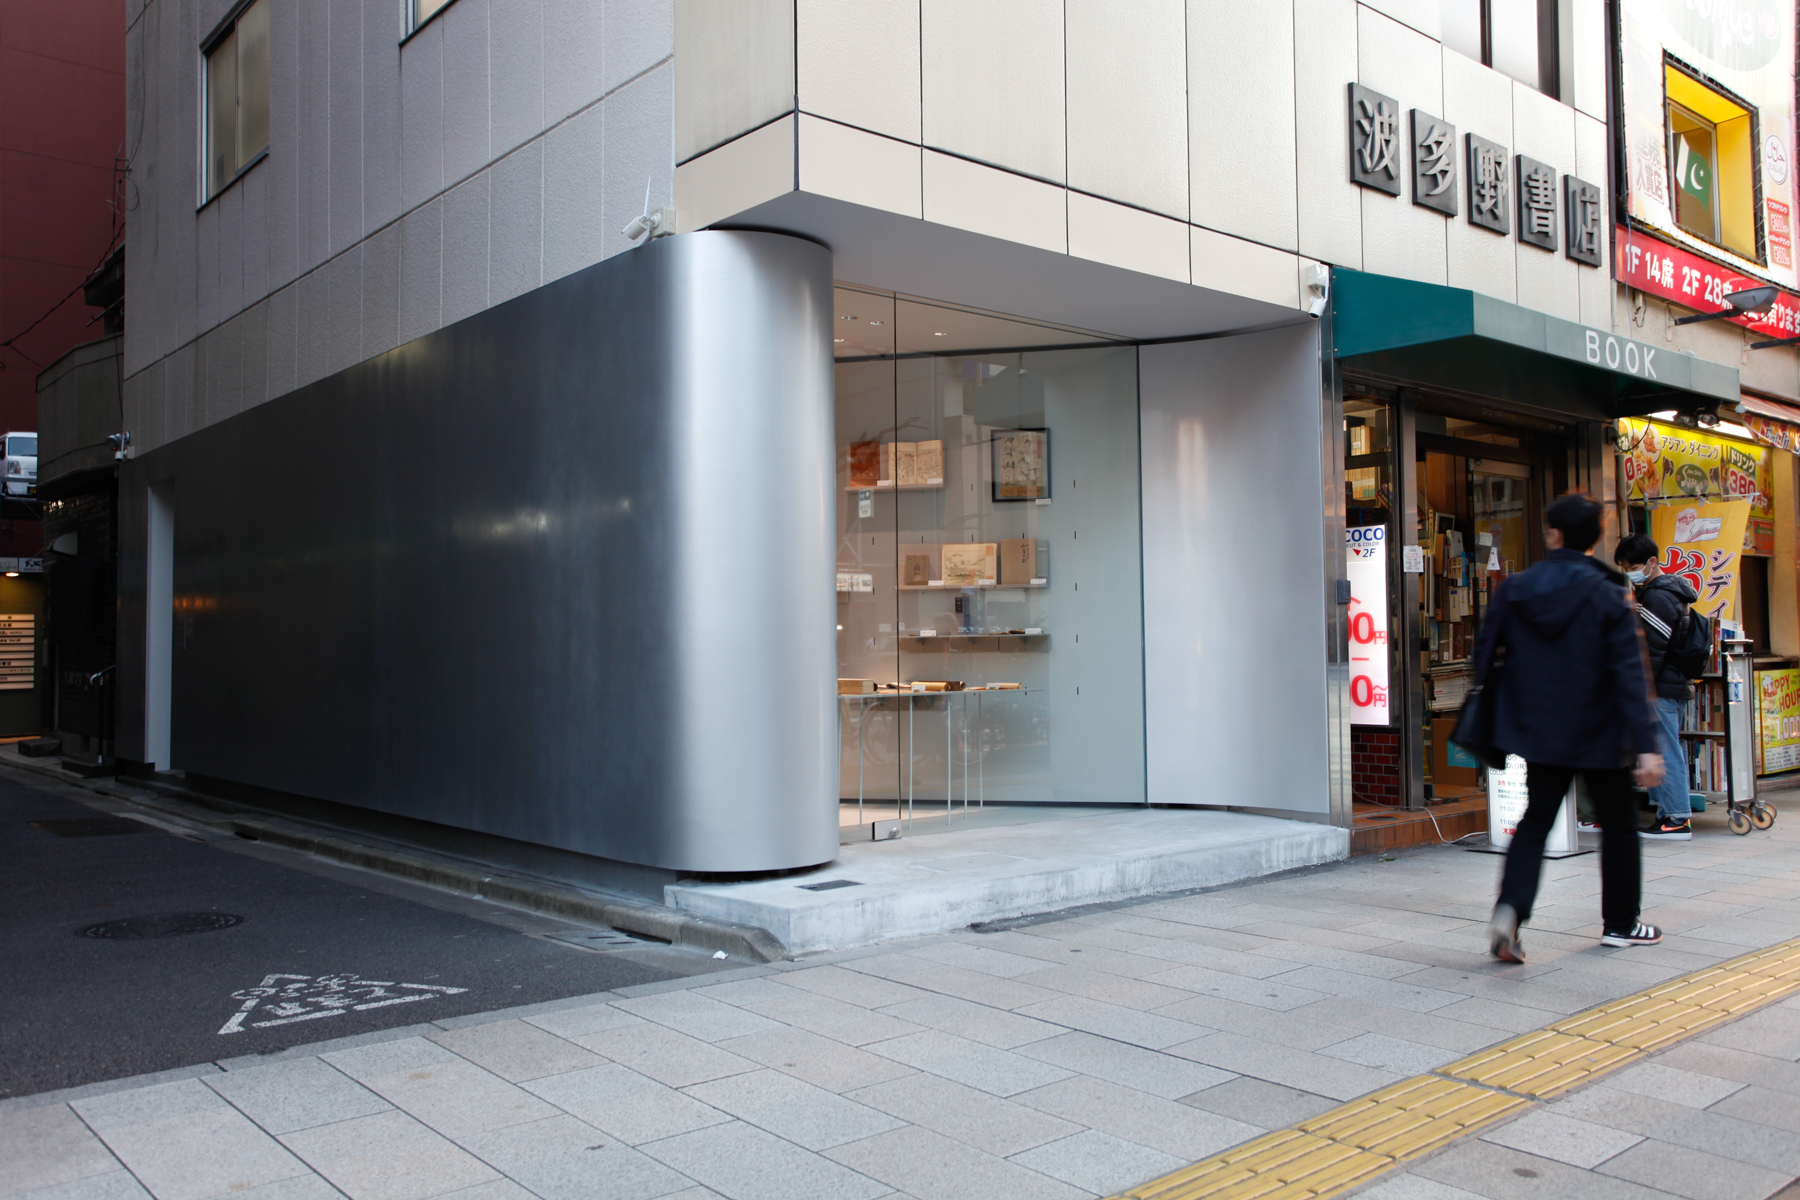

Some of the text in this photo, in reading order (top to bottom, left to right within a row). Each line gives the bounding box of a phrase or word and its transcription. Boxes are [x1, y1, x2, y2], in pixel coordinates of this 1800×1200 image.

[1357, 100, 1601, 255] 波多野書店
[1625, 243, 1641, 274] 1F
[1645, 251, 1674, 289] 14席
[1682, 266, 1700, 296] 2F
[1585, 329, 1657, 379] BOOK
[1661, 435, 1720, 461] アジアン ダイニング
[1731, 449, 1756, 474] ドリンク
[1362, 548, 1376, 558] 2F
[1763, 673, 1791, 698] HAPPY
